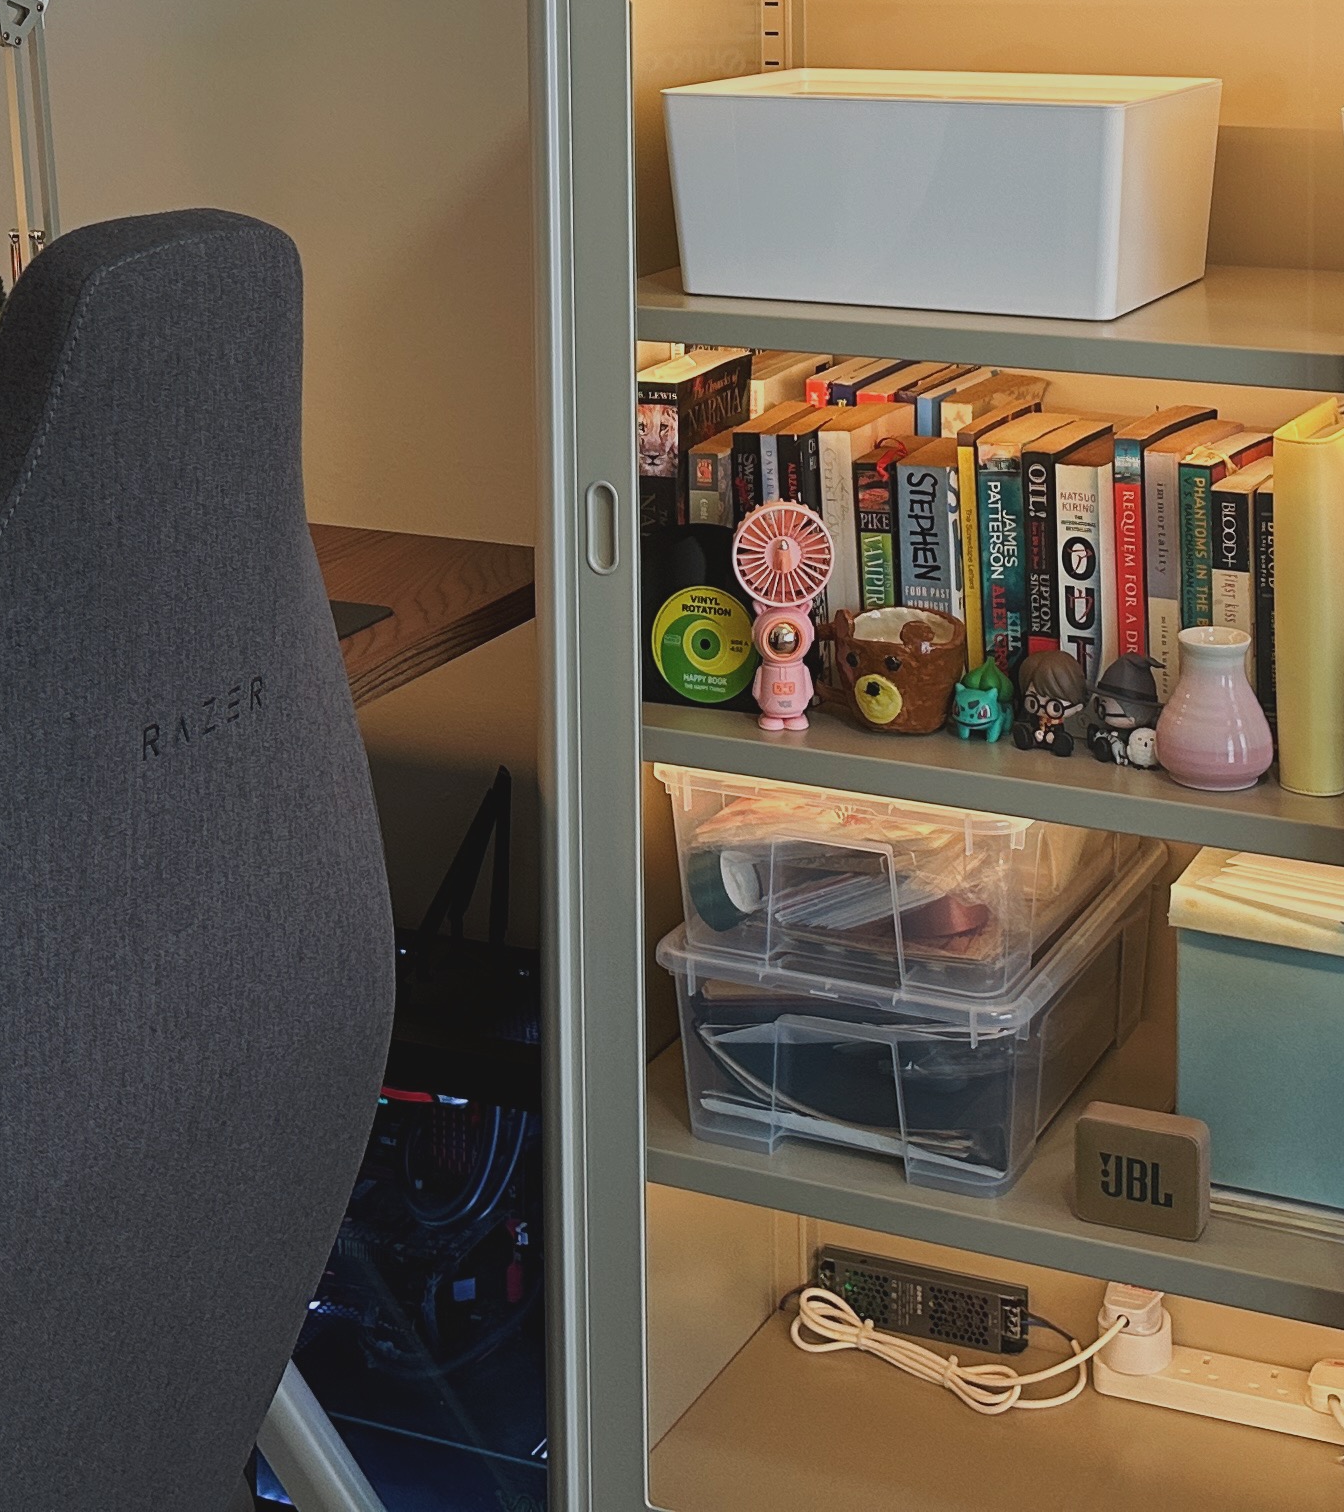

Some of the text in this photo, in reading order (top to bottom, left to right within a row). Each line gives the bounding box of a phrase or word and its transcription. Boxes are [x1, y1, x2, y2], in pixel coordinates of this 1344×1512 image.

[649, 390, 677, 400] LEWIS
[688, 388, 742, 432] NARNIA
[1028, 463, 1047, 518] OIL!
[1060, 492, 1096, 503] NATSUO
[1062, 502, 1094, 513] KIRINO
[860, 513, 889, 529] PIKE
[906, 472, 942, 582] STEPHEN
[987, 481, 1004, 579] PATTERSON
[1003, 510, 1018, 567] JAMES
[1122, 490, 1135, 567] REQUIEM
[1156, 482, 1168, 575] immortality
[1194, 477, 1207, 558] PHANTOMS
[905, 585, 950, 599] FOUR PAST
[1124, 574, 1137, 606] FOR
[1197, 564, 1207, 578] IN
[681, 604, 732, 617] ROTATION
[690, 595, 720, 606] VINYL
[992, 584, 1006, 629] ALEX
[1030, 574, 1040, 632] SINCLAIR
[1041, 574, 1052, 634] UPTON
[1126, 614, 1137, 624] A
[1197, 586, 1208, 612] THE
[1007, 611, 1021, 651] KILL
[683, 673, 727, 686] HAPPY BOOK
[142, 675, 264, 761] RAZER
[1099, 1152, 1173, 1208] JBL
